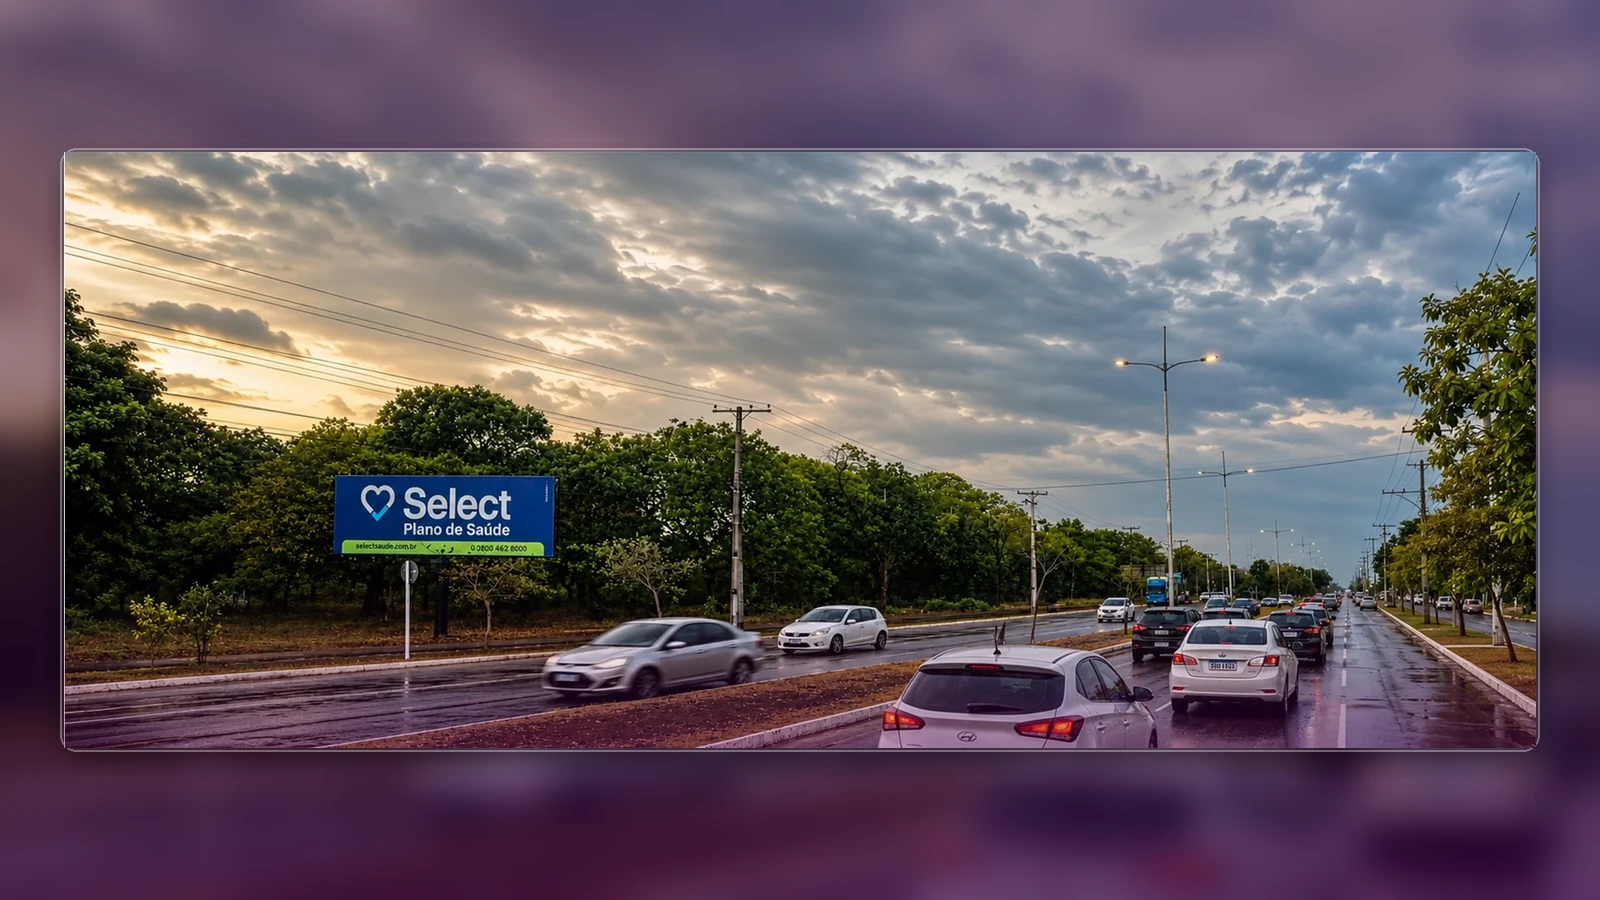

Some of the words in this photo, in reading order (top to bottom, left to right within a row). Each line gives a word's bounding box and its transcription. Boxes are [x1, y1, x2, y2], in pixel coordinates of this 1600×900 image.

[403, 486, 511, 520] Select
[403, 522, 442, 535] Plano
[445, 522, 463, 536] de
[466, 522, 510, 536] Saúde
[356, 542, 417, 550] selectsaude.com.br
[476, 544, 493, 552] 0800
[495, 544, 508, 552] 462
[510, 544, 527, 552] 8000
